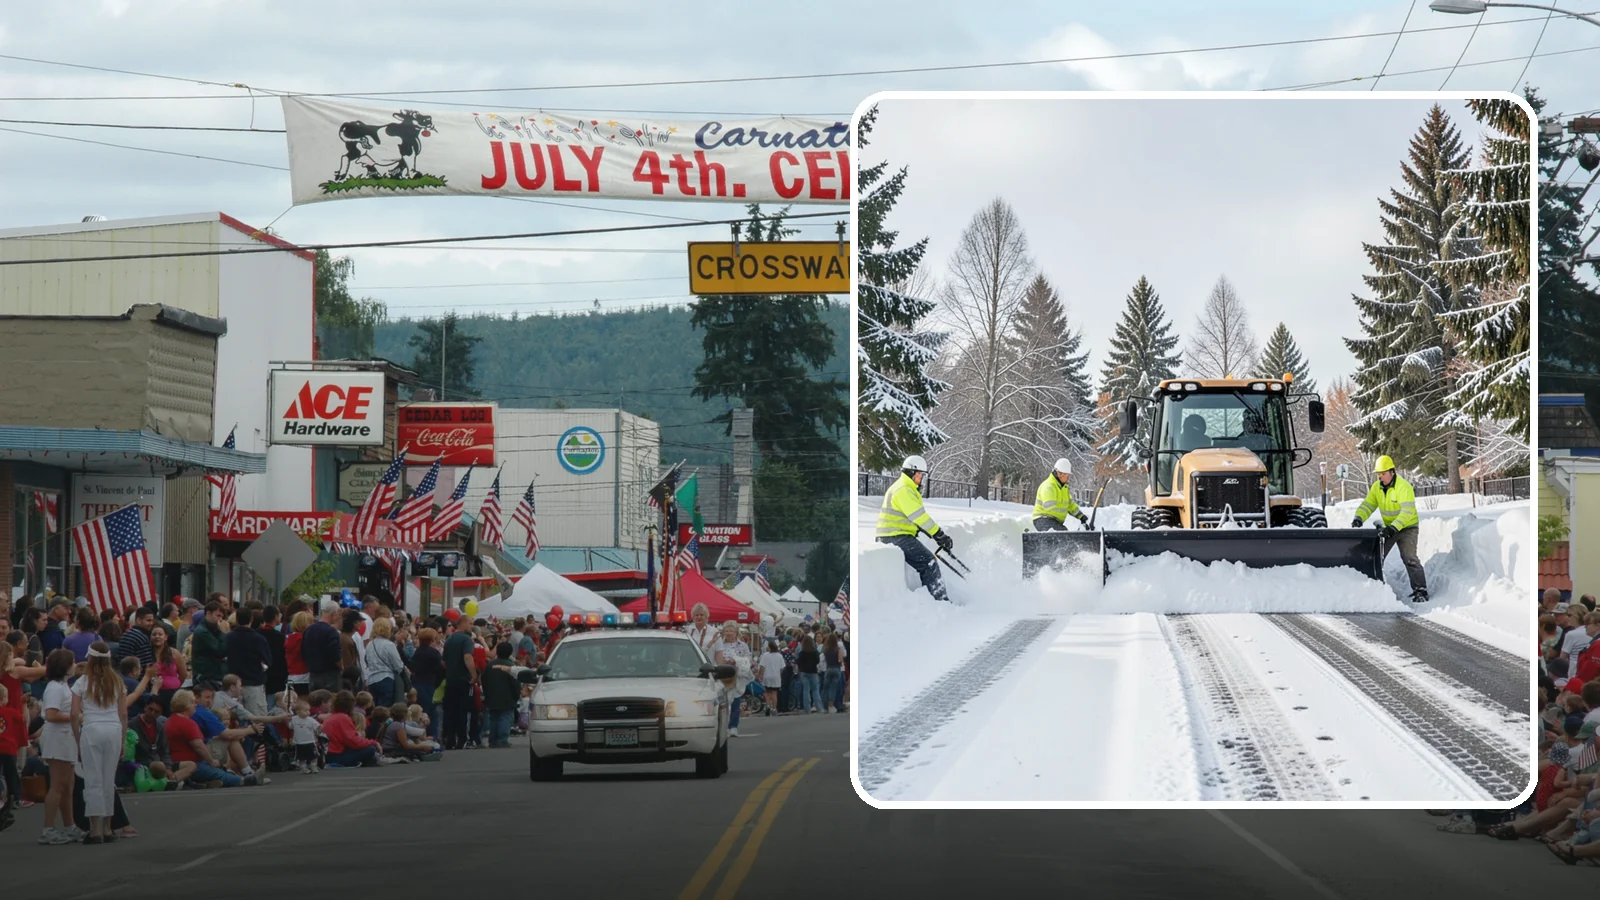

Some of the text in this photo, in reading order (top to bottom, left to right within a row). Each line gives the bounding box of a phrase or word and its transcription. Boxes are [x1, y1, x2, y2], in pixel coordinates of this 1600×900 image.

[695, 121, 850, 149] Carnat
[481, 140, 605, 193] JULY
[632, 150, 746, 198] 4th.
[697, 254, 850, 280] CROSSWA
[282, 379, 374, 420] ACE
[406, 409, 452, 421] CEDAR
[283, 421, 371, 437] Hardware
[353, 467, 384, 481] Simpl
[95, 485, 124, 495] Vincent
[126, 486, 136, 495] de
[138, 486, 155, 495] Paul
[688, 526, 741, 535] CRNATION
[699, 535, 730, 543] GLASS
